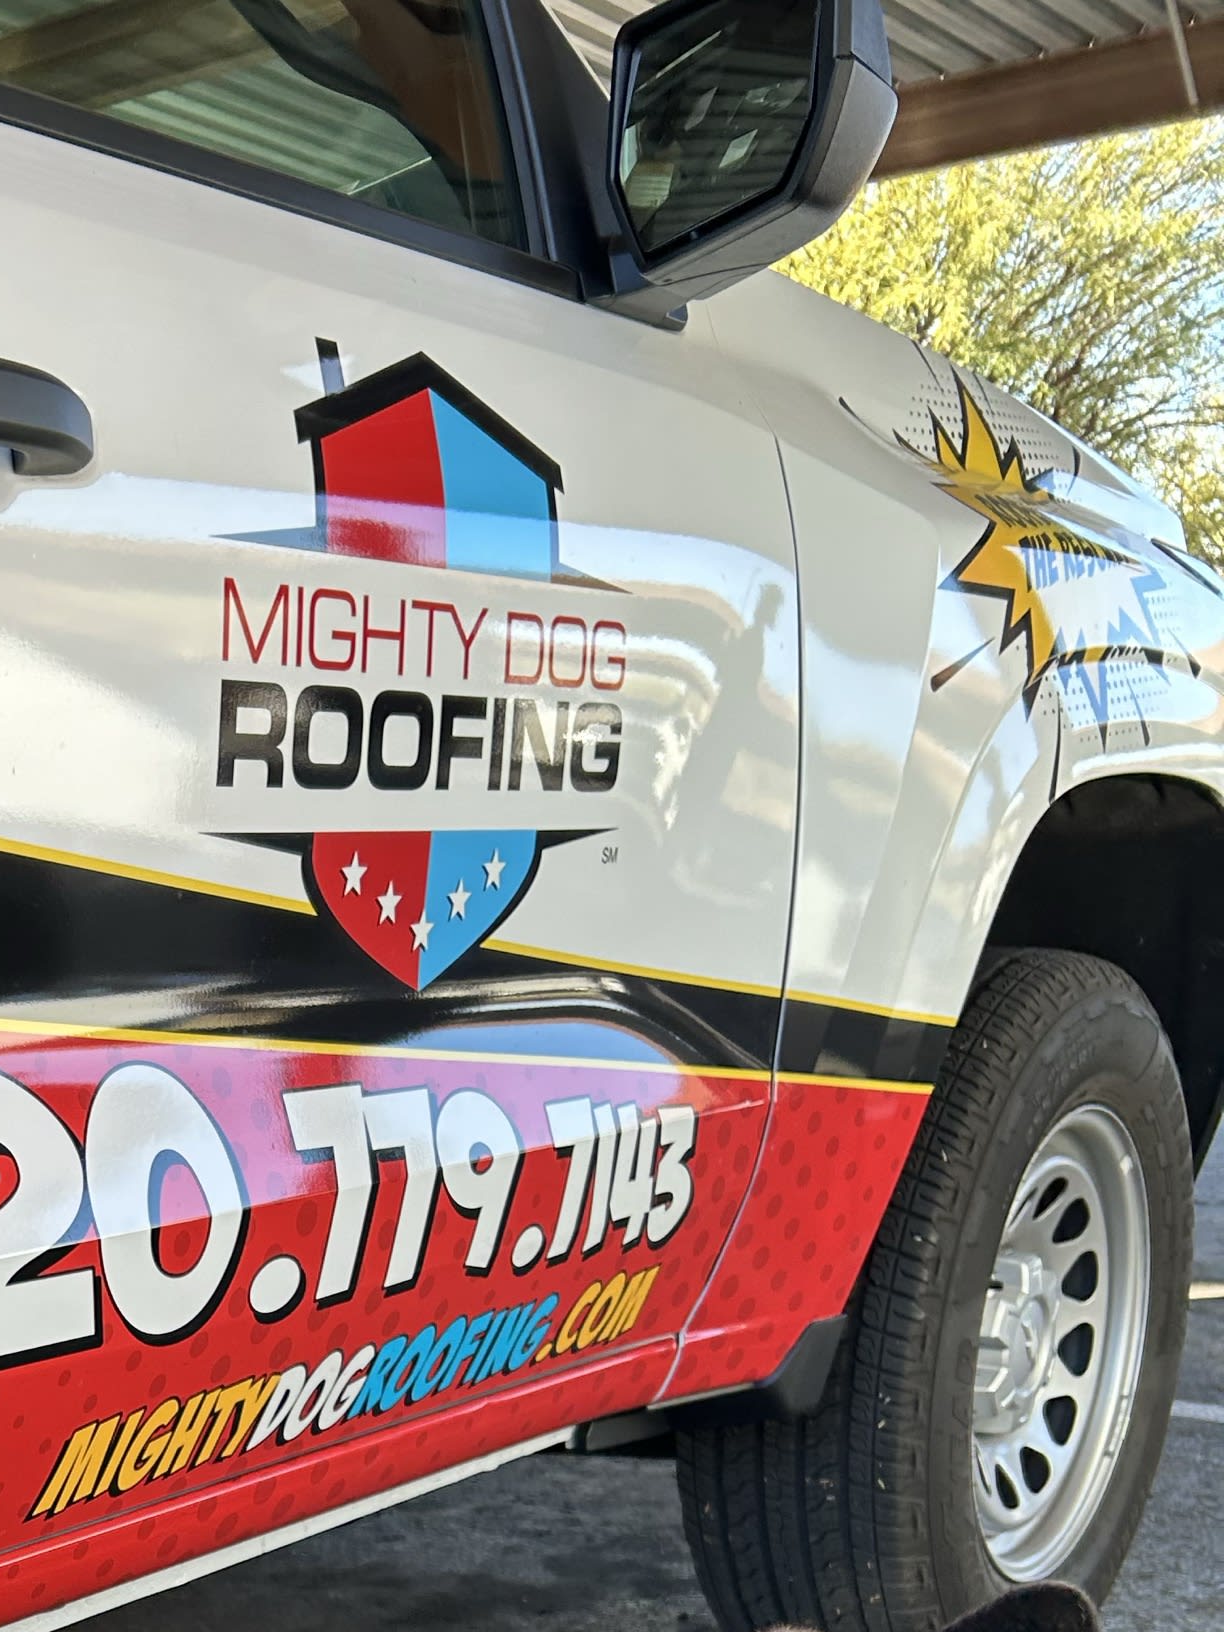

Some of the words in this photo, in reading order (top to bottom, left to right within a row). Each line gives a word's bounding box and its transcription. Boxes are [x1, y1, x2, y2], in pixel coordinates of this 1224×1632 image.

[1018, 531, 1060, 592] THE
[222, 577, 487, 679] MIGHTY
[505, 611, 627, 690] DOG
[217, 680, 623, 792] ROOFING
[601, 846, 619, 865] SM
[25, 1264, 660, 1521] MIGHTYDOGROOFING.COM
